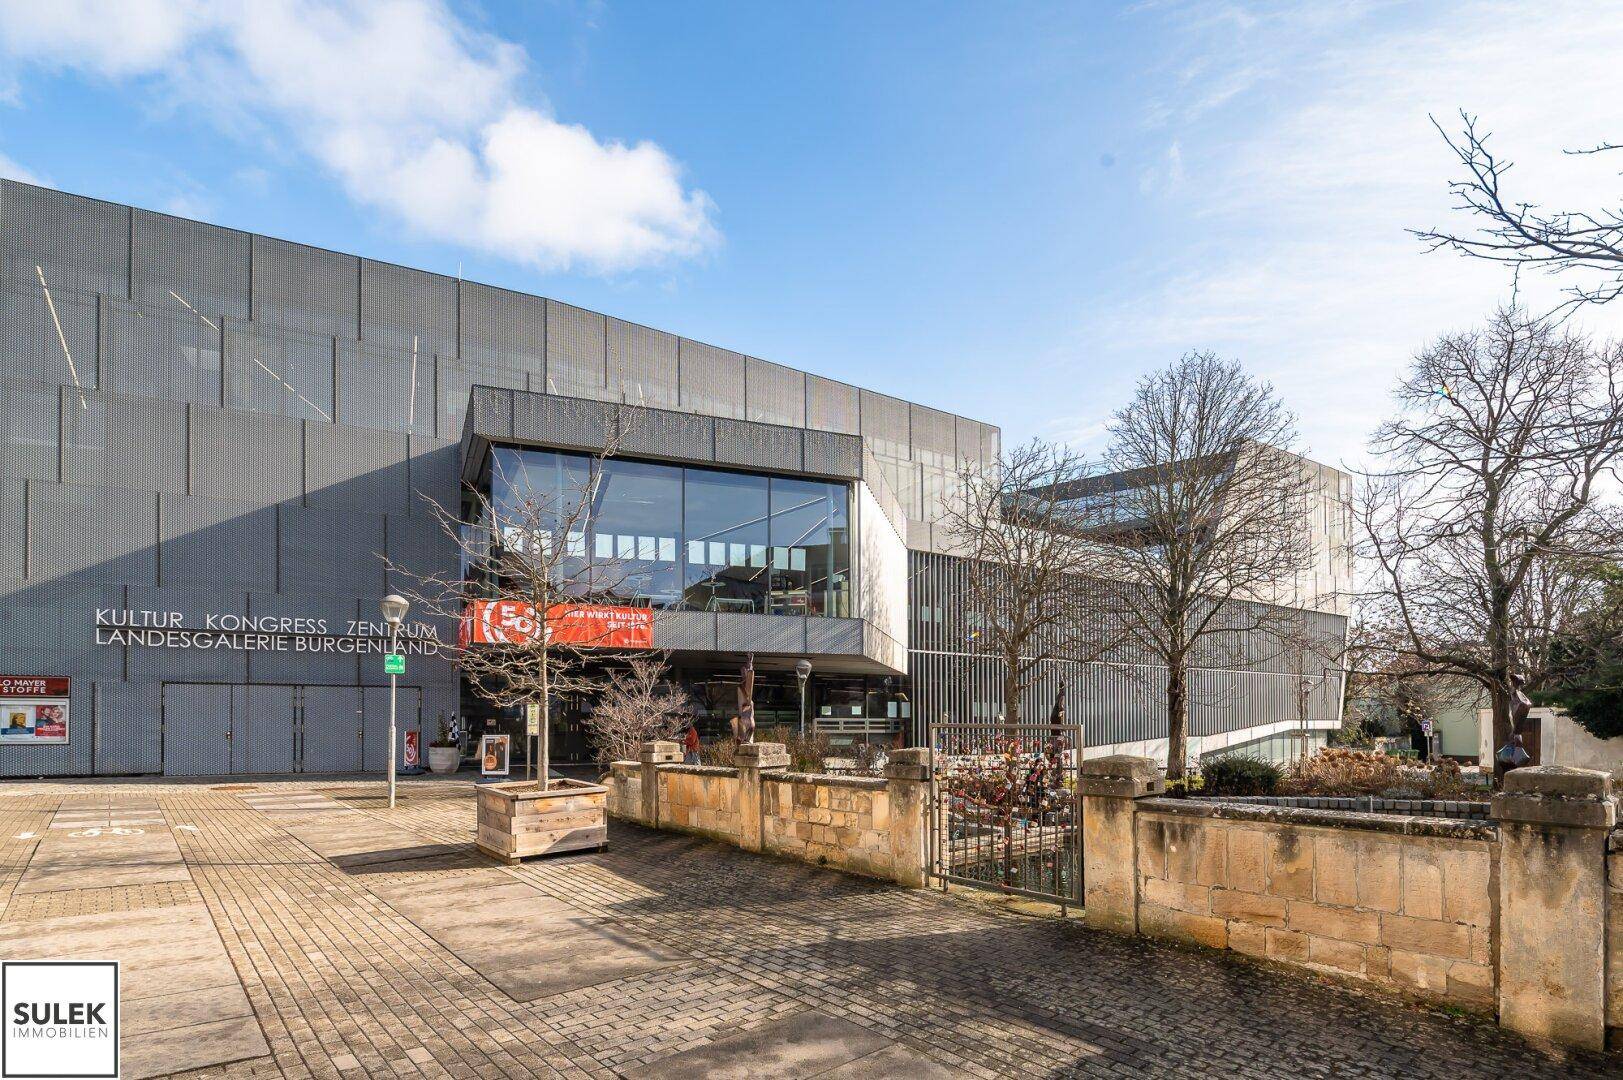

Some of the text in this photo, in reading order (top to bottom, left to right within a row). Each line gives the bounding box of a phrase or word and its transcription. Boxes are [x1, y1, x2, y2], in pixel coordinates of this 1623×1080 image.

[586, 611, 615, 619] WIRKT
[615, 613, 648, 621] KULTUR
[96, 608, 438, 639] KULTUR KONGRESS ZENTRUM
[607, 621, 626, 629] SEIT
[96, 628, 438, 655] LANDESGALERIE BURGENLAND
[14, 679, 46, 687] MAYER
[2, 686, 46, 694] STOFFE
